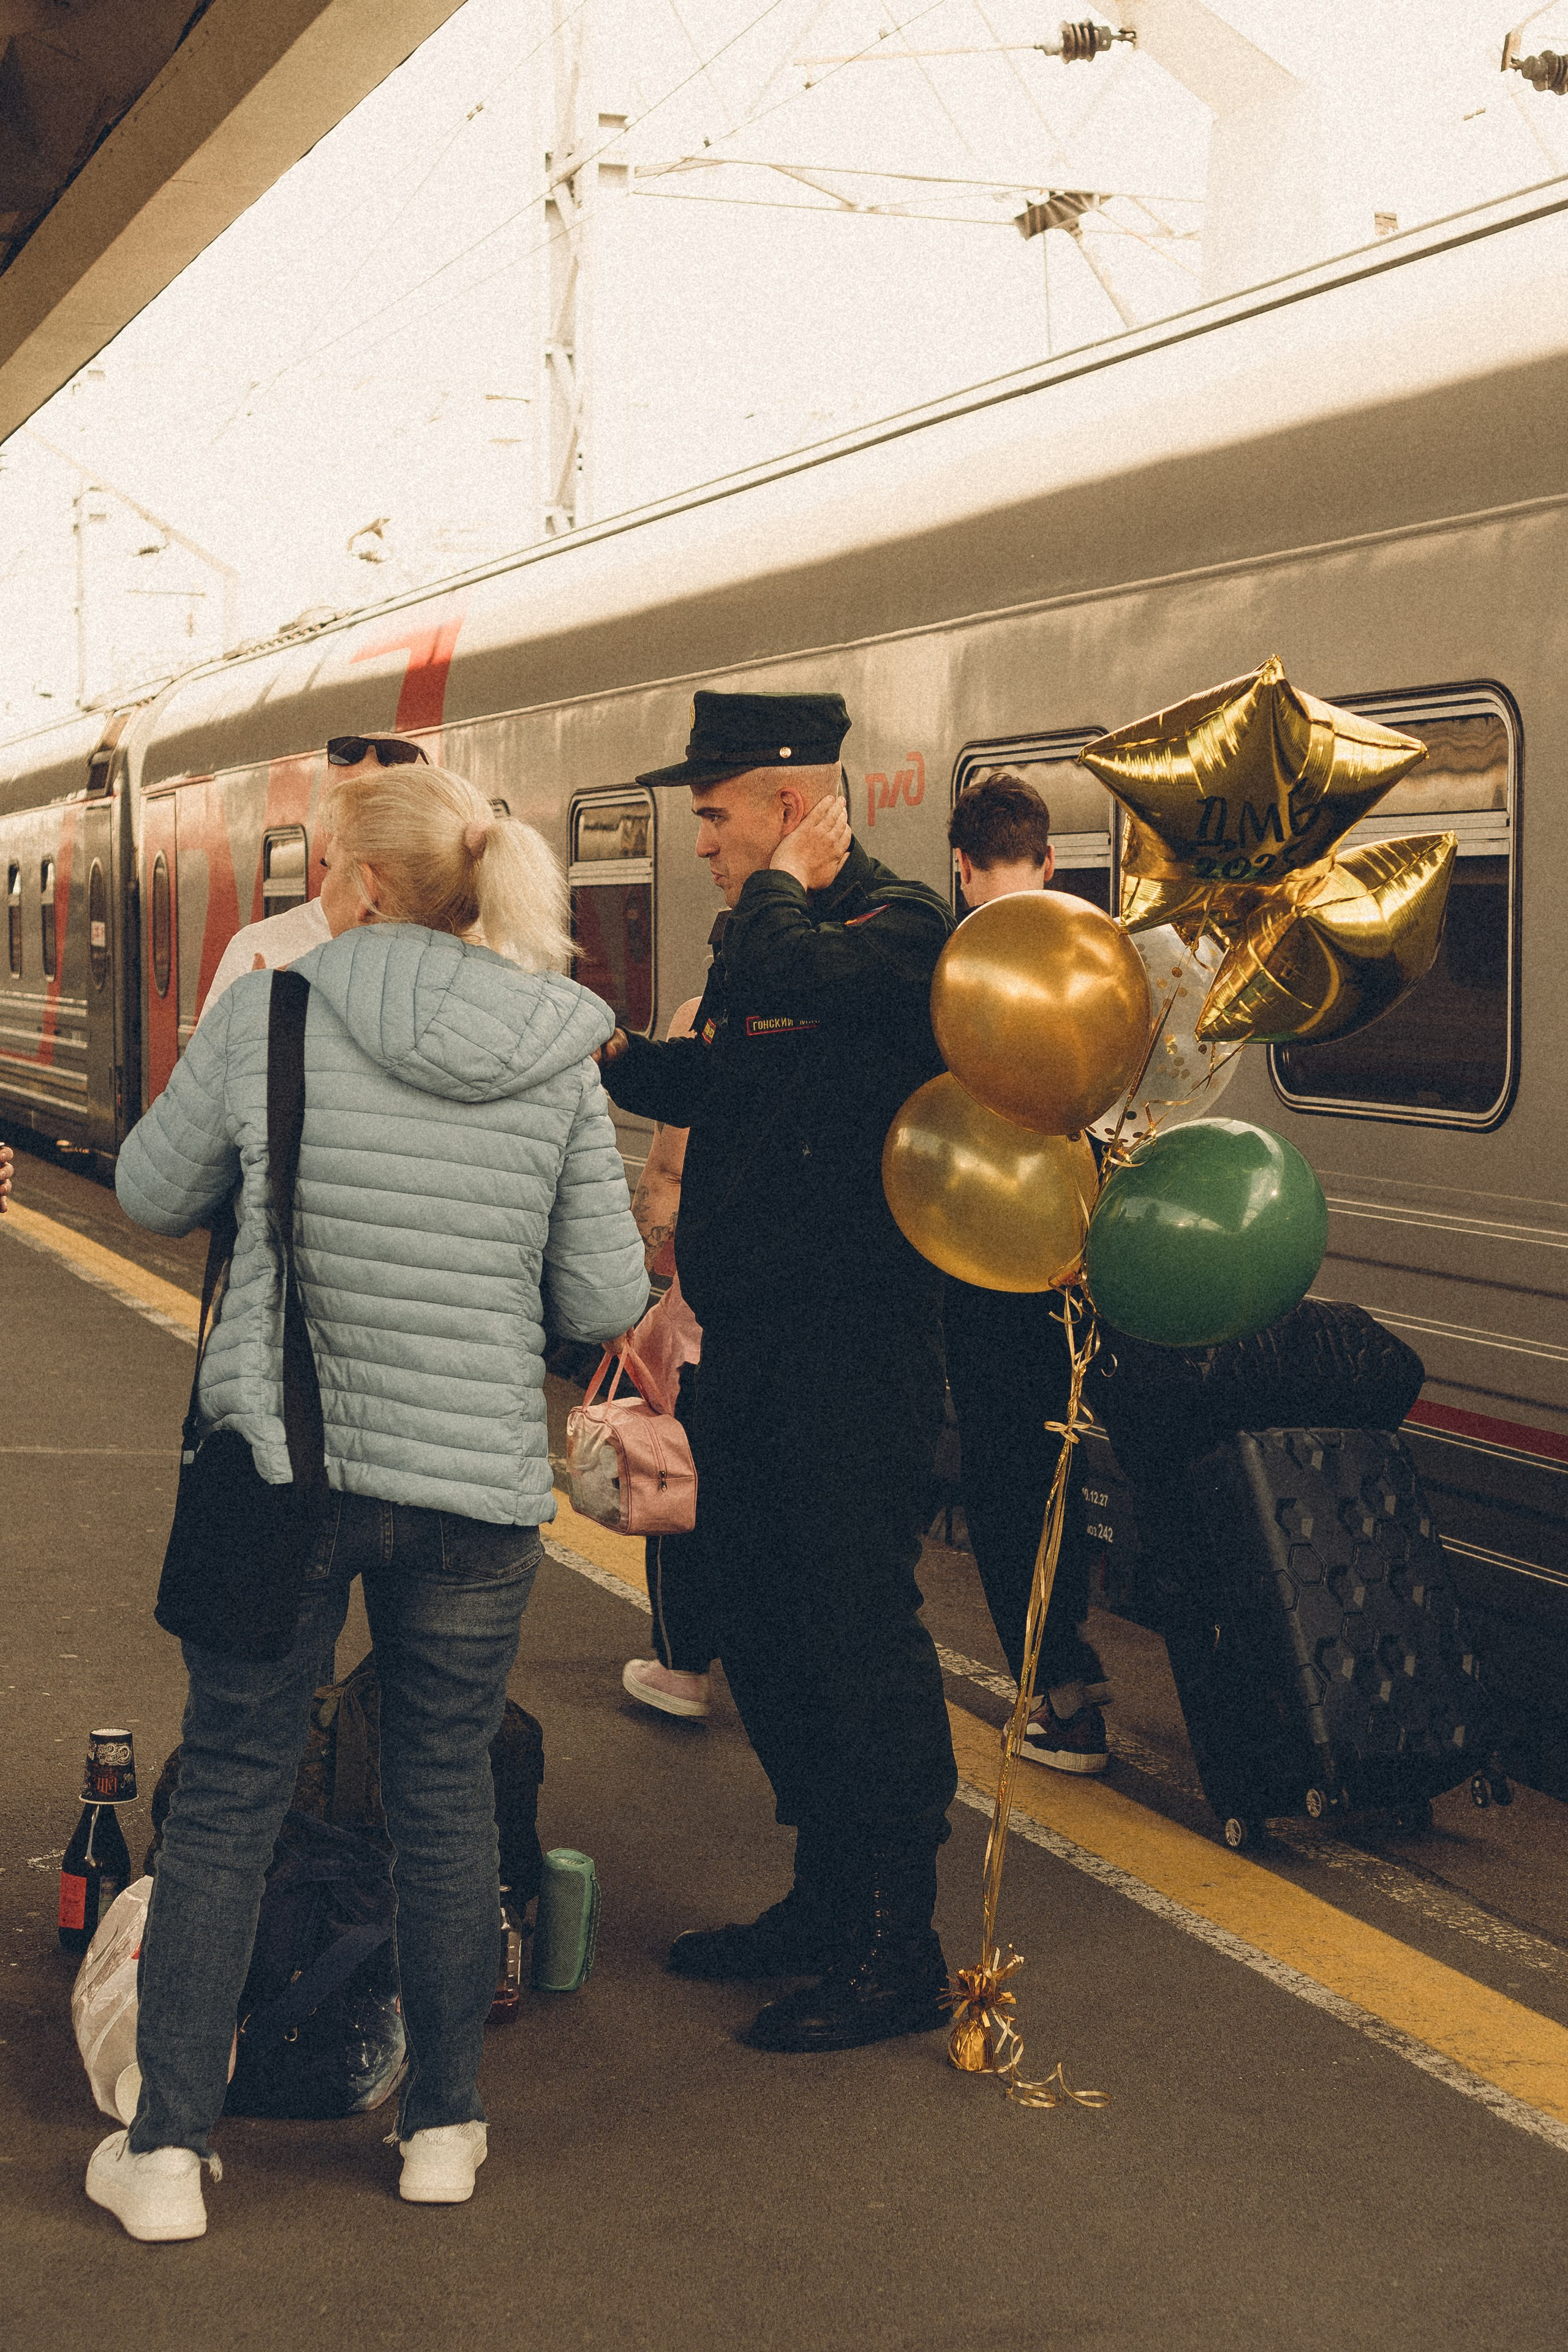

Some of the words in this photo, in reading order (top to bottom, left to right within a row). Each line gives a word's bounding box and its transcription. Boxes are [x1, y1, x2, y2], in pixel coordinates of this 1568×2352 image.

[1196, 777, 1319, 853] ДМБ
[1196, 840, 1306, 878] 2025
[1098, 1523, 1114, 1543] 242
